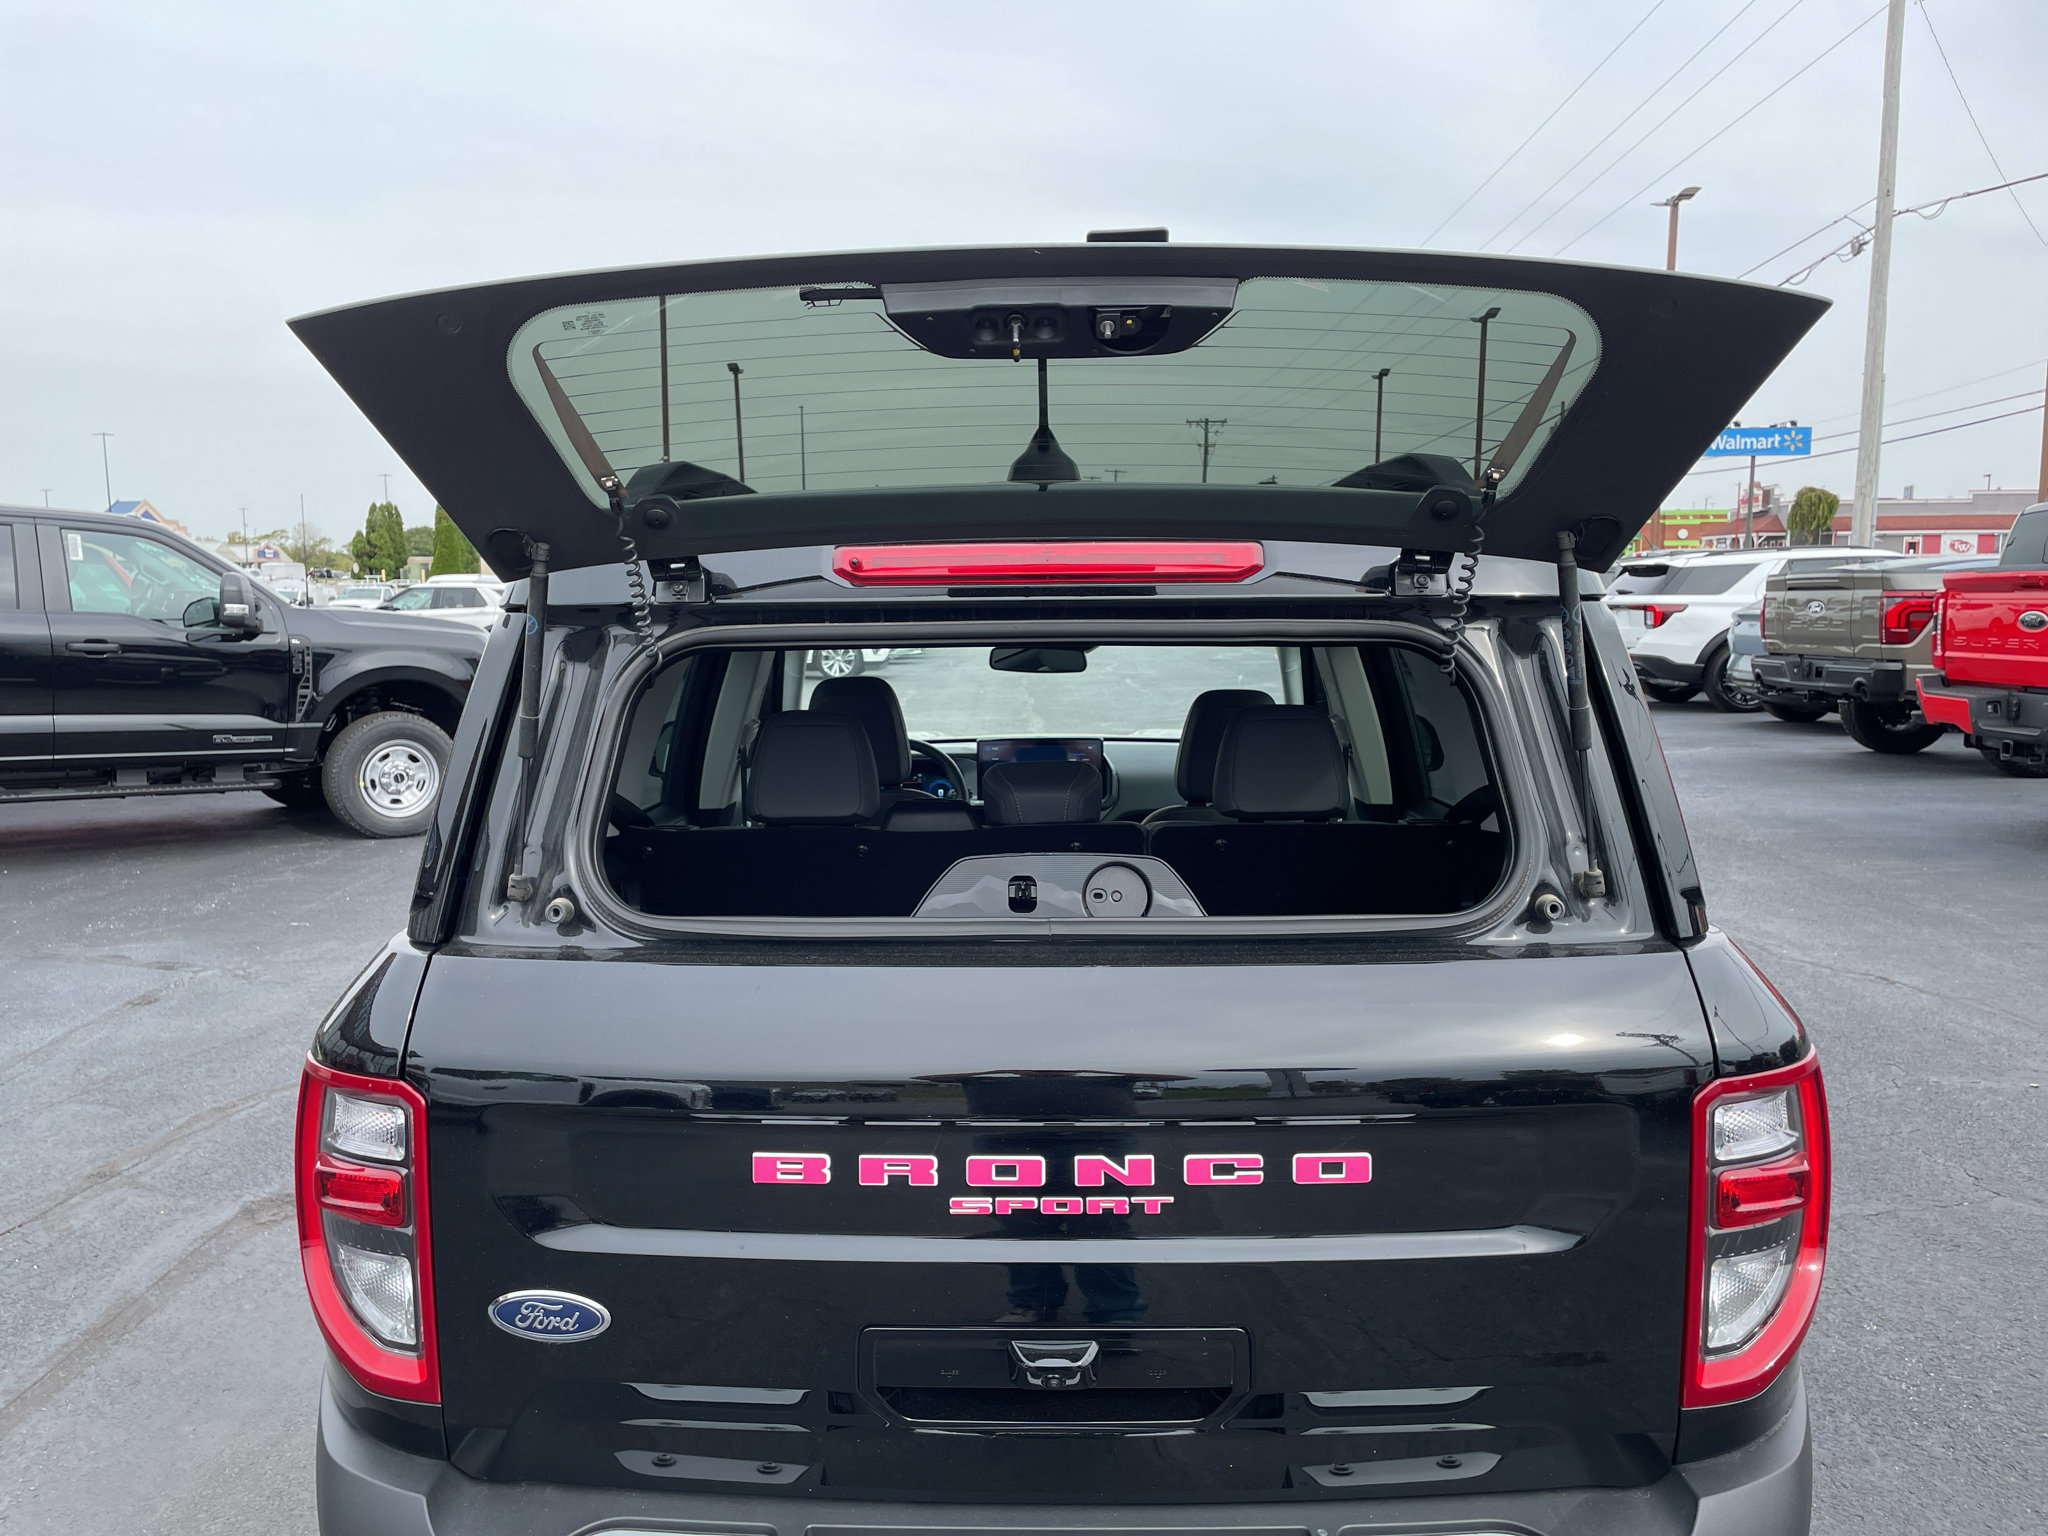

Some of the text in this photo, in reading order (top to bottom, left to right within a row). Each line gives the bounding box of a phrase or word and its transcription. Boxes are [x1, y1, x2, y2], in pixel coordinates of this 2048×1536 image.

[1711, 434, 1781, 450] Walmart
[1953, 636, 2039, 649] SUPER
[752, 1152, 1372, 1187] BRONCO
[949, 1197, 1175, 1215] SPORT
[514, 1301, 580, 1331] Ford
